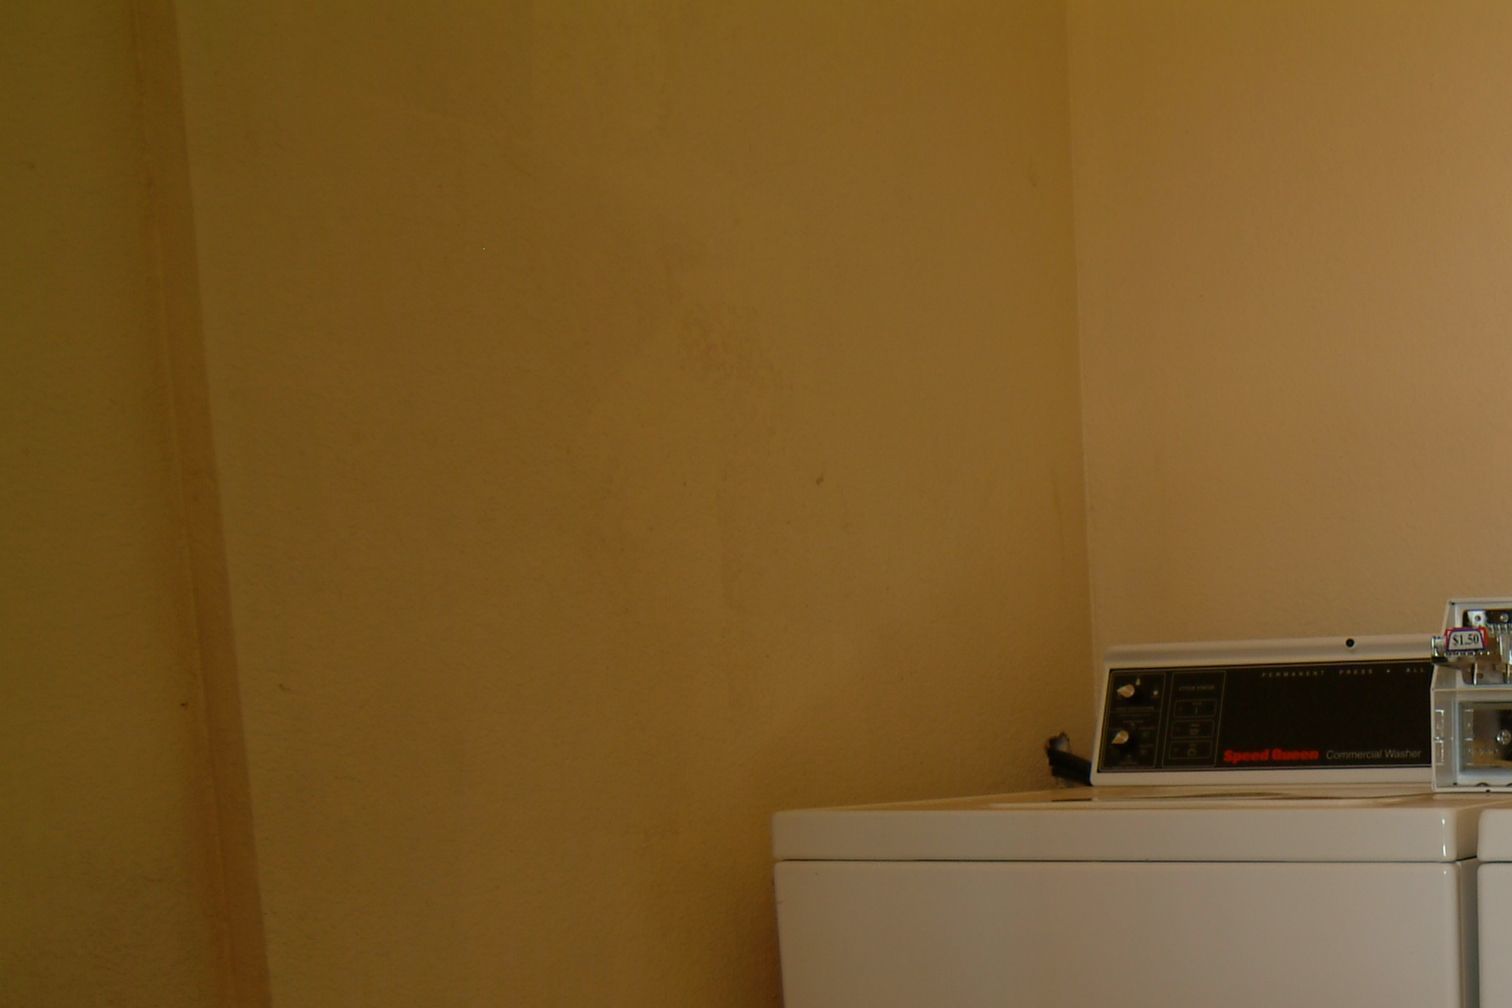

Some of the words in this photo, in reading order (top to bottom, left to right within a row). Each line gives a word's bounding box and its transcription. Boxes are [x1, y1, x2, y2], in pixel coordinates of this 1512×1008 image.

[1452, 634, 1479, 646] $1.50
[1224, 749, 1269, 764] Speed
[1272, 748, 1319, 761] Queen
[1326, 749, 1381, 760] Commercial
[1384, 749, 1421, 760] Washer
